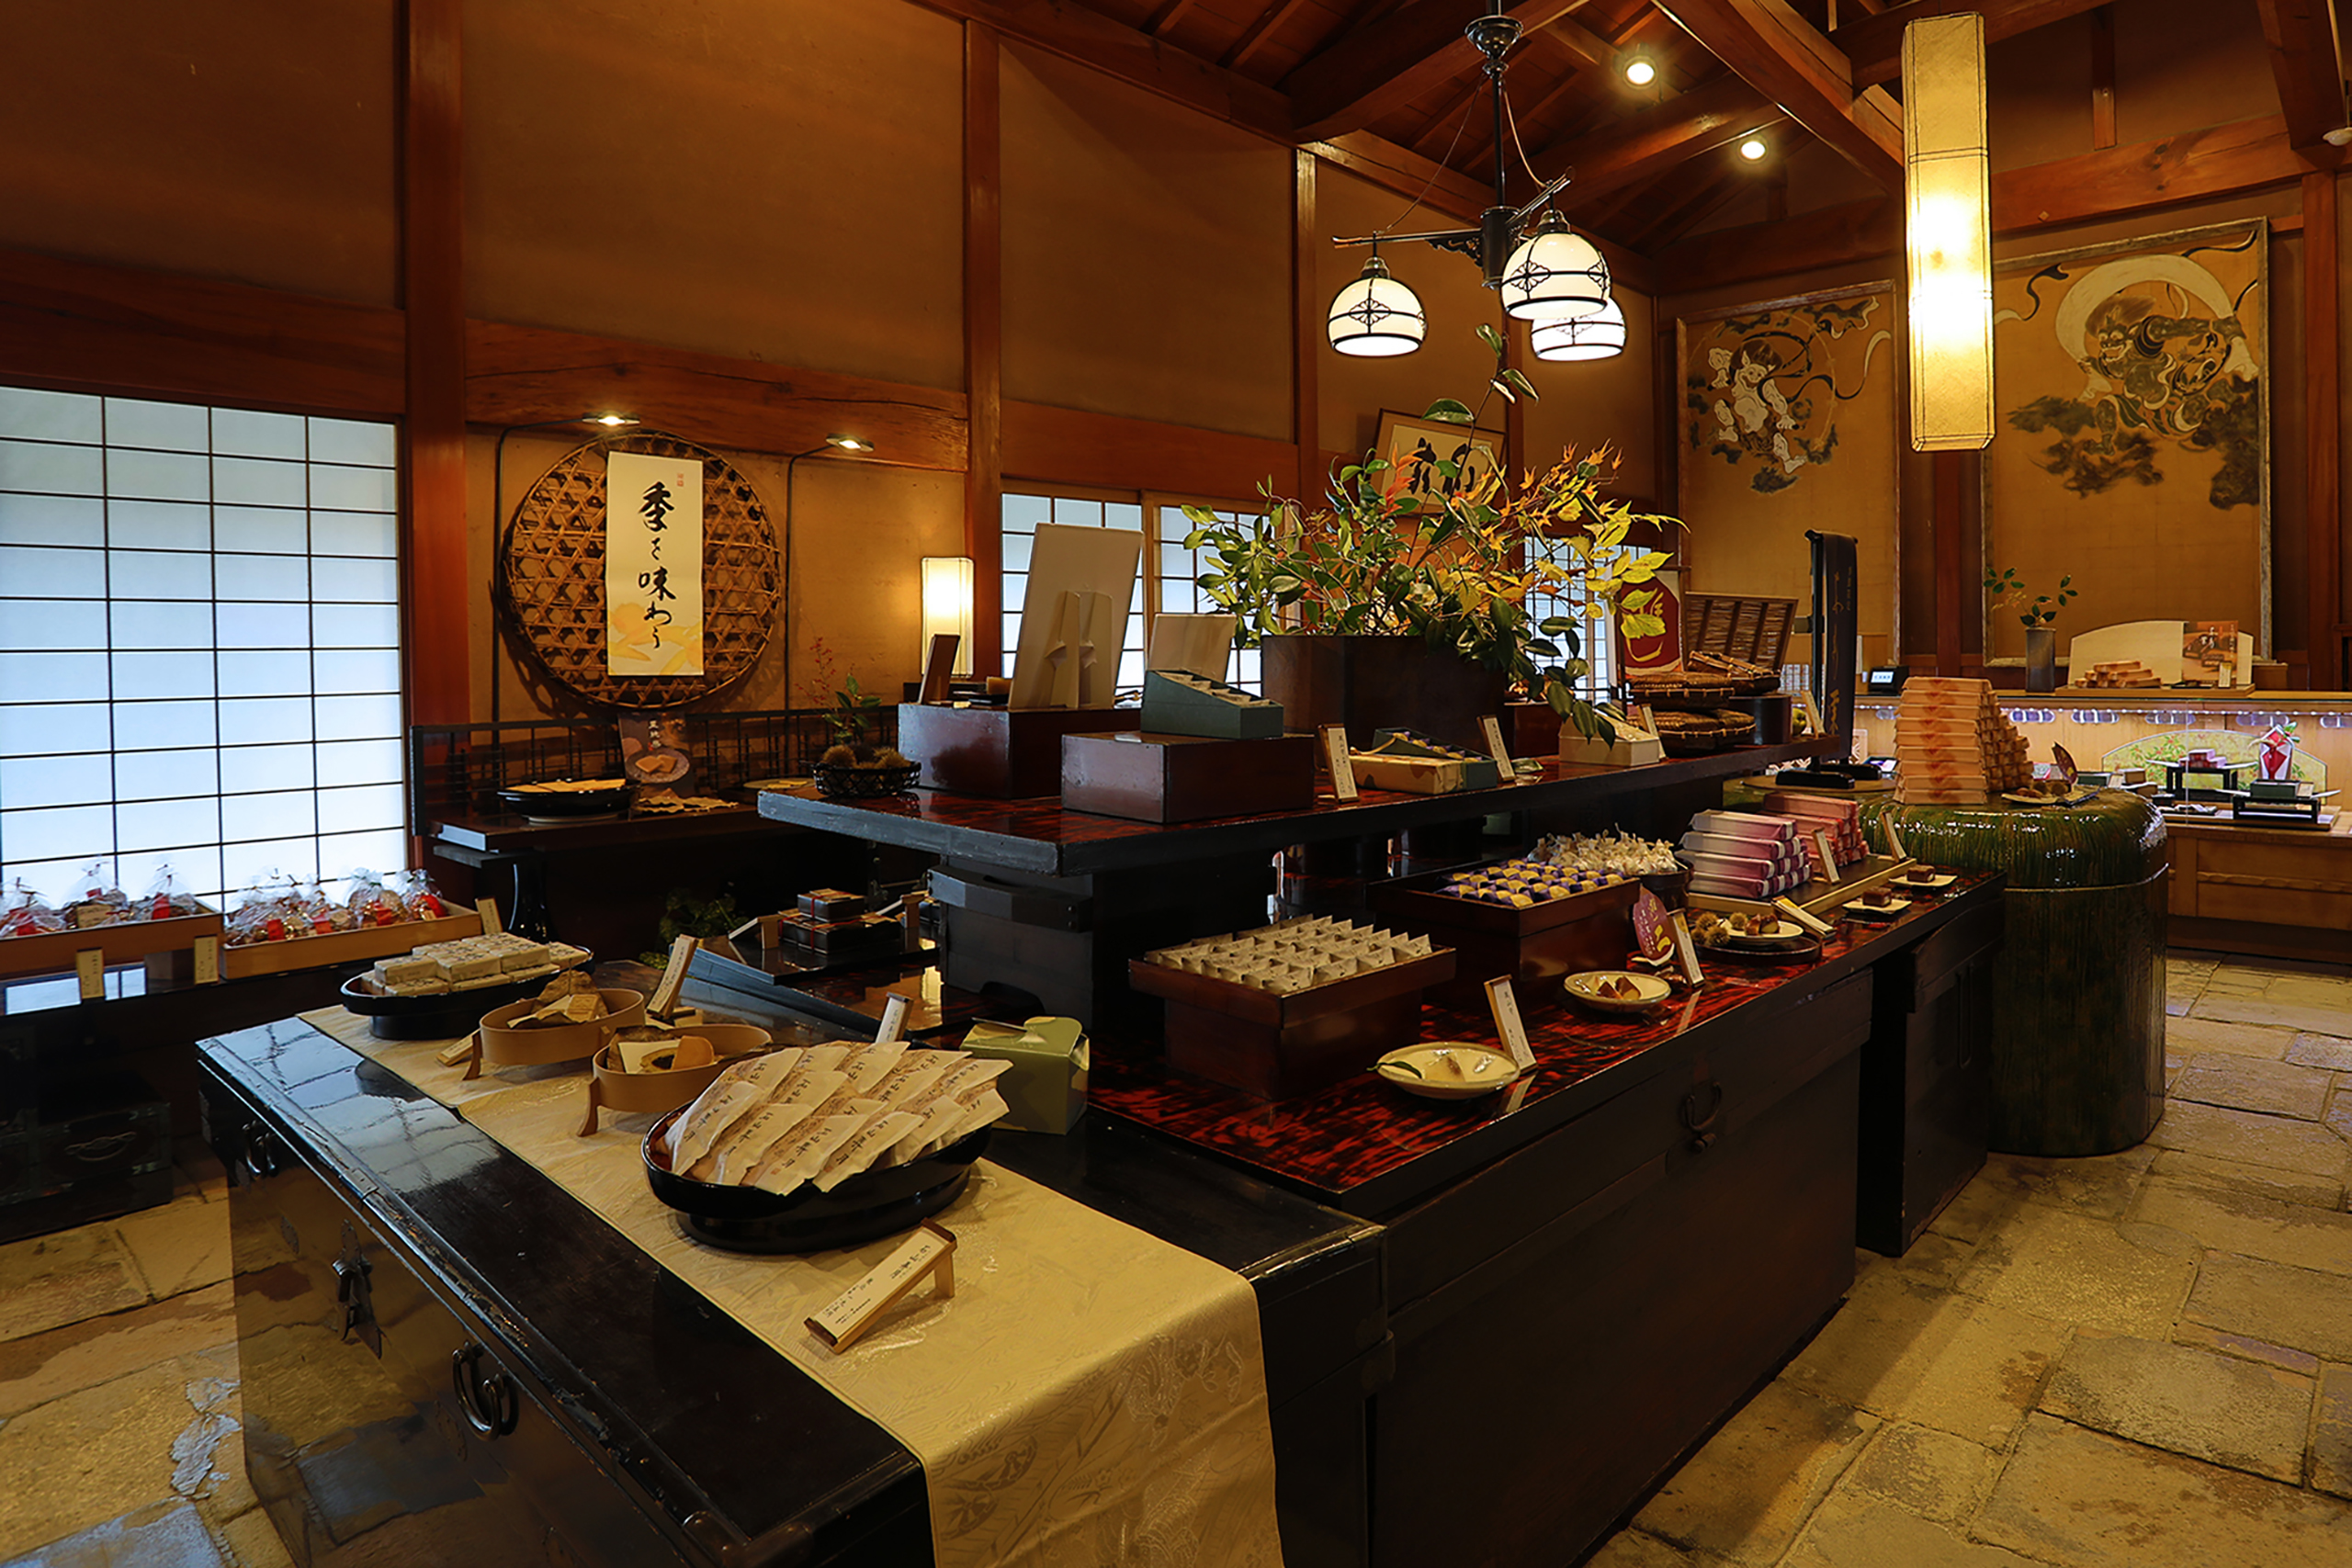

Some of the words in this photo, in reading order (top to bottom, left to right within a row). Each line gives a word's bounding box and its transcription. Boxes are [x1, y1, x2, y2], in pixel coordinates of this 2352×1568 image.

[638, 480, 677, 649] 季を味わう
